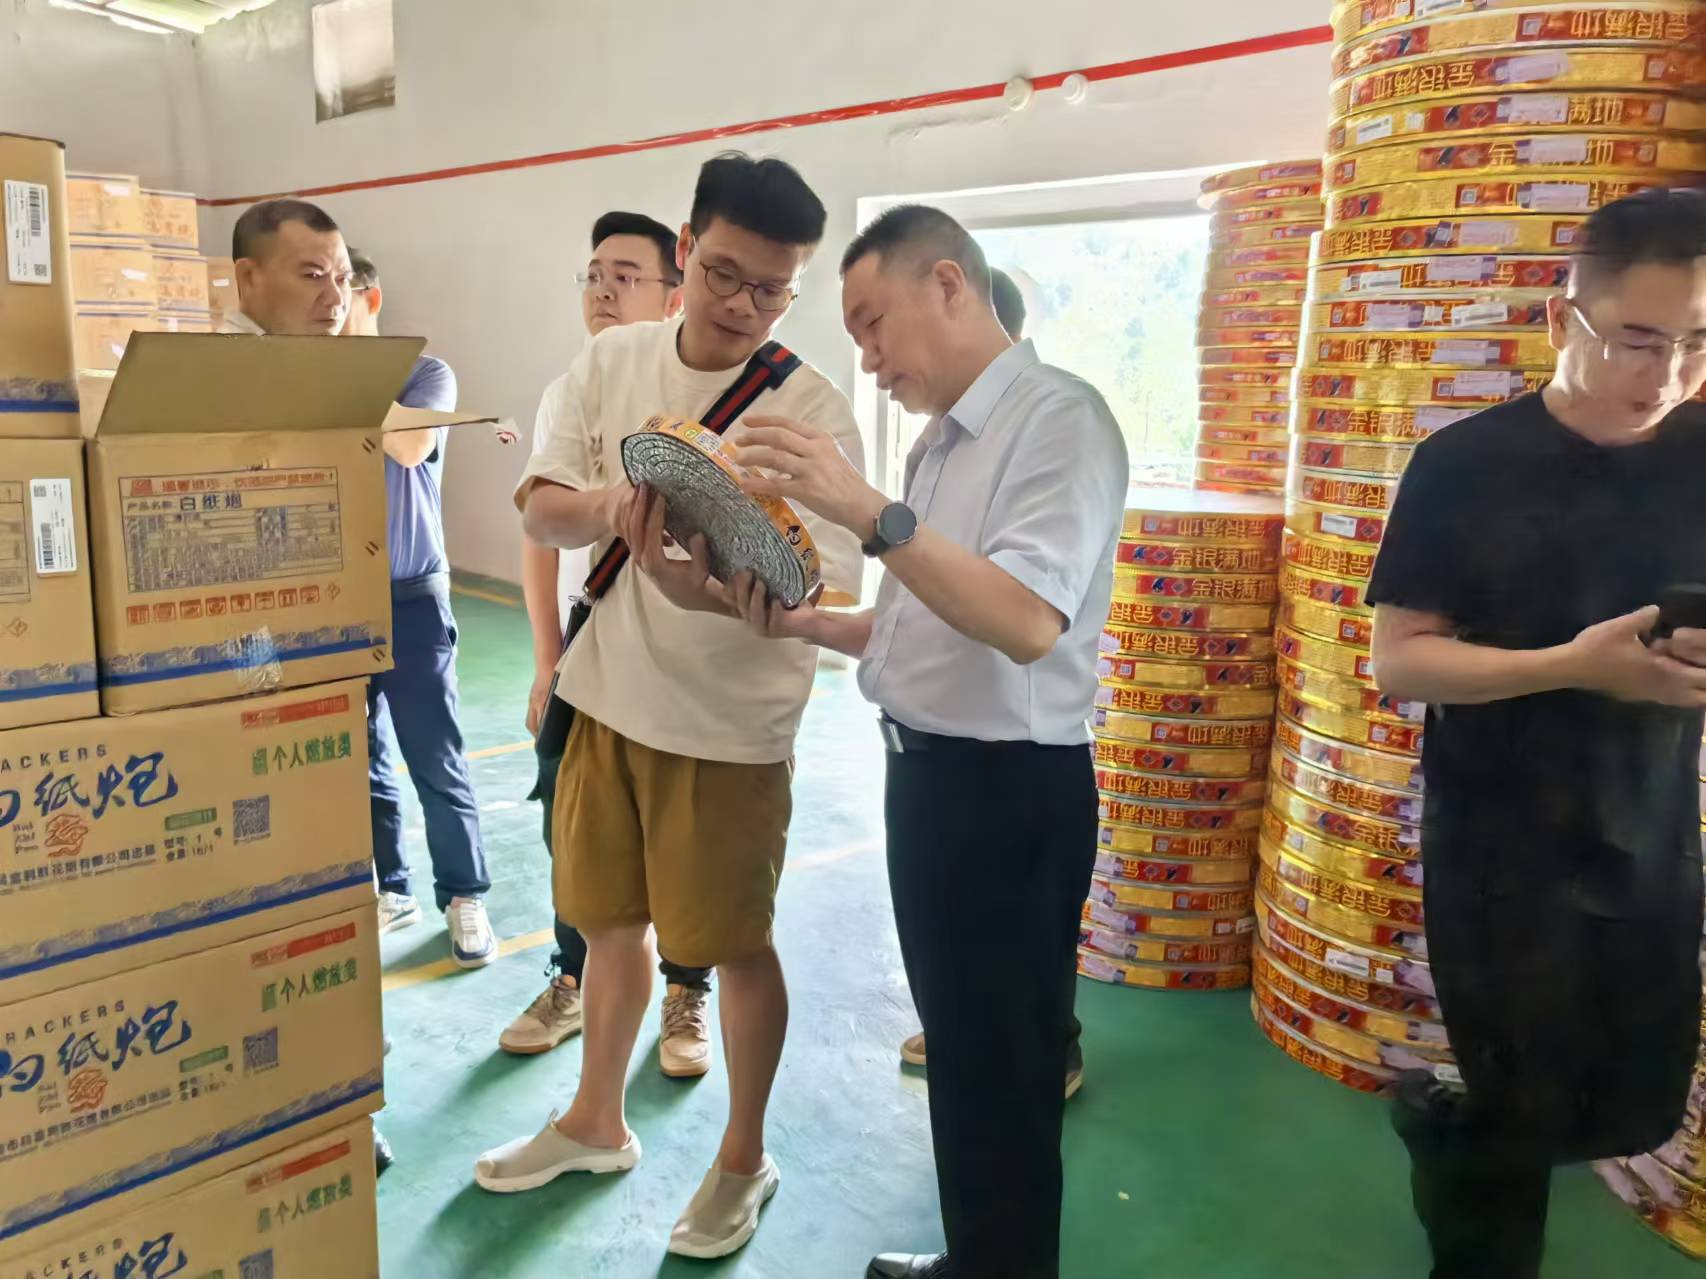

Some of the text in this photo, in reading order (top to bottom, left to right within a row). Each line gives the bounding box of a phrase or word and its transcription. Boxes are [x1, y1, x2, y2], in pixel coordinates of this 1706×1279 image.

[1373, 61, 1476, 100] 金银满地
[1173, 547, 1261, 570] 金银满地
[1301, 872, 1391, 917] 金银满地
